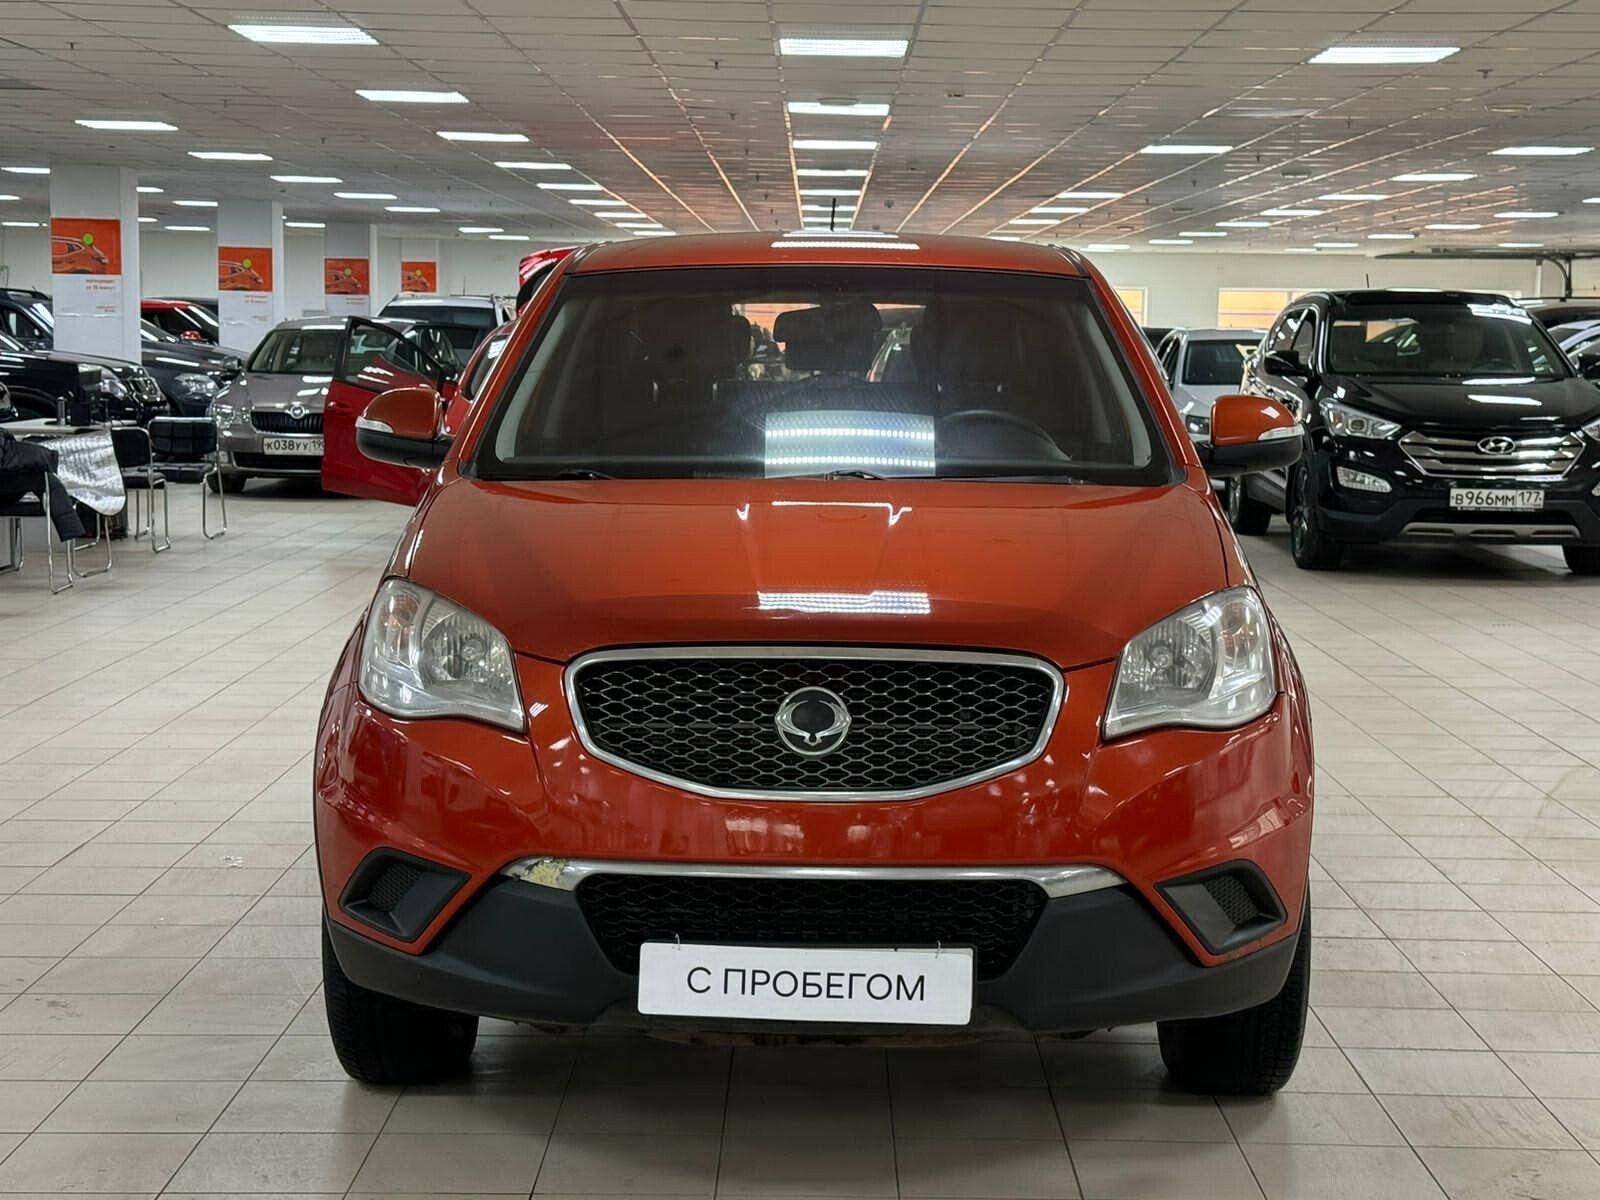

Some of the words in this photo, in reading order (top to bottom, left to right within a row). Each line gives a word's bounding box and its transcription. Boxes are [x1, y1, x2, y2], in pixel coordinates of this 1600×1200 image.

[1455, 491, 1515, 505] В966ММ
[1519, 491, 1541, 505] 177
[687, 966, 712, 993] С
[723, 968, 925, 1001] ПРОБЕГОМ
